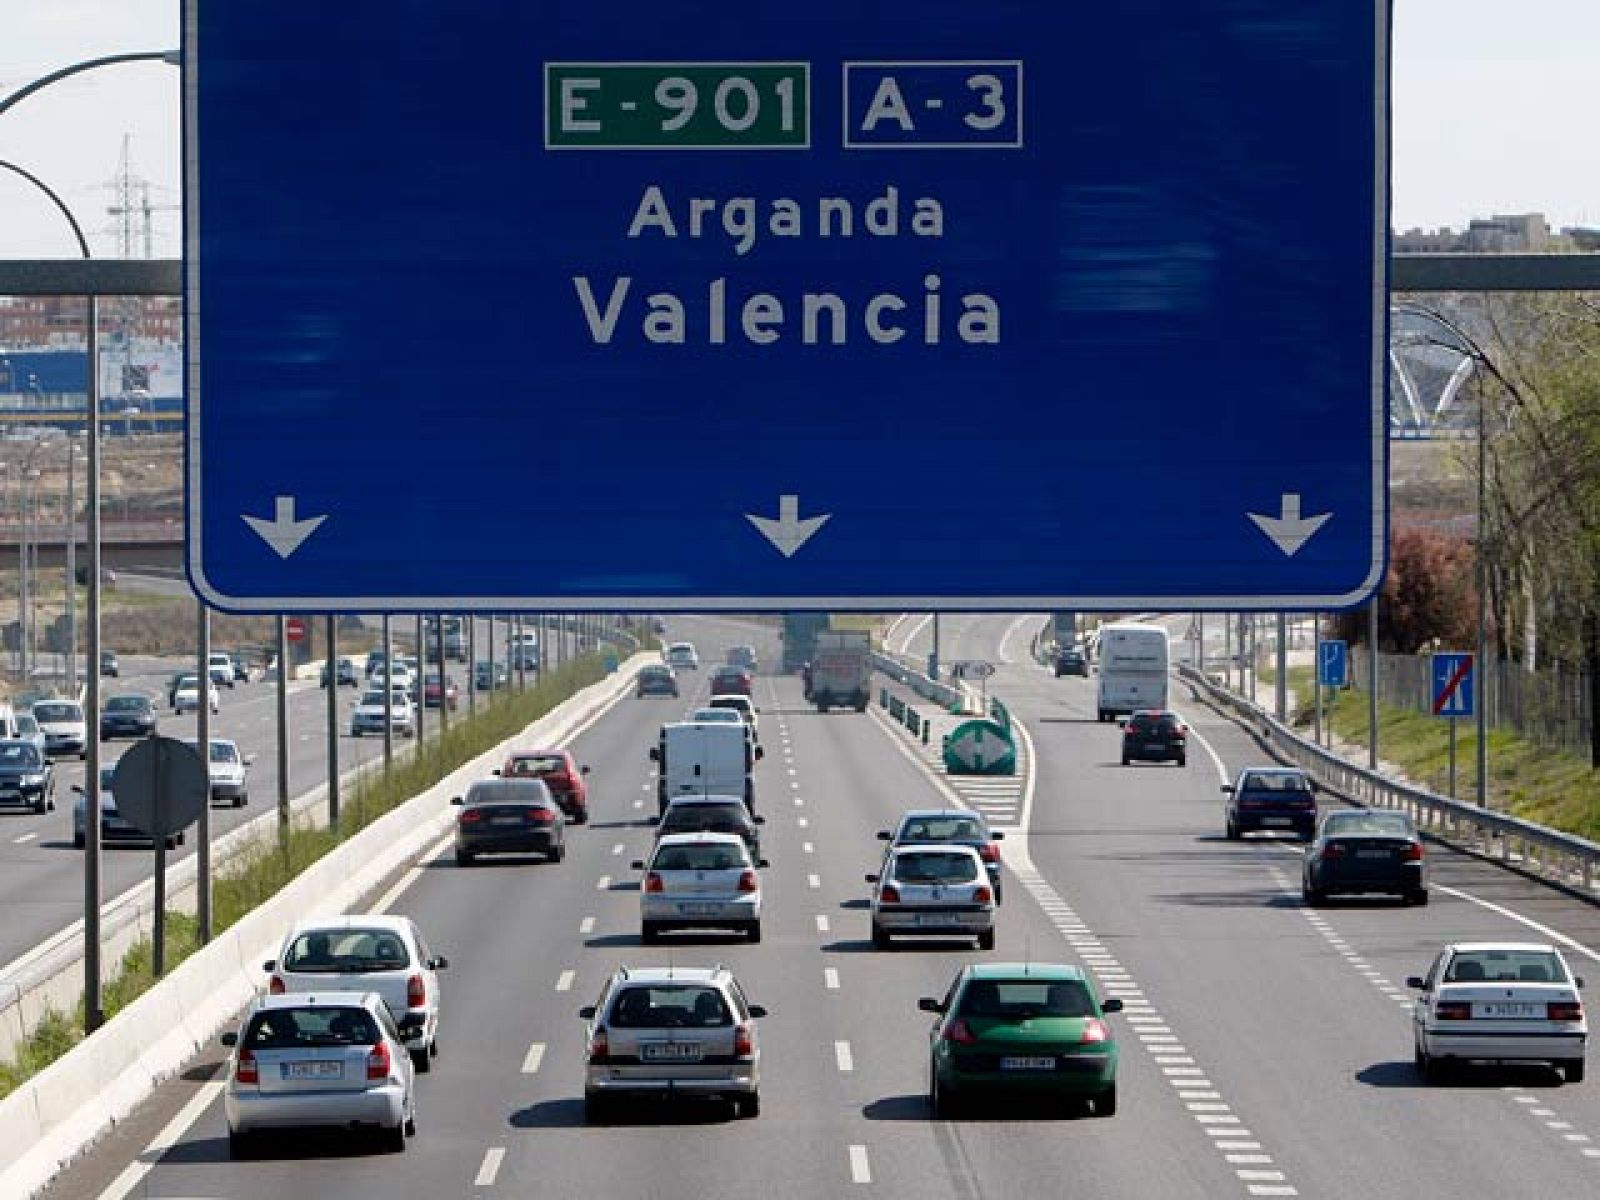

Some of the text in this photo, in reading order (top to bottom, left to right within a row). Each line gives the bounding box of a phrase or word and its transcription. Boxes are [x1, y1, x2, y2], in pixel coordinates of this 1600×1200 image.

[561, 77, 795, 132] E-901
[861, 74, 1007, 132] A-3
[628, 186, 943, 254] Arganda
[573, 274, 1000, 345] Valencia
